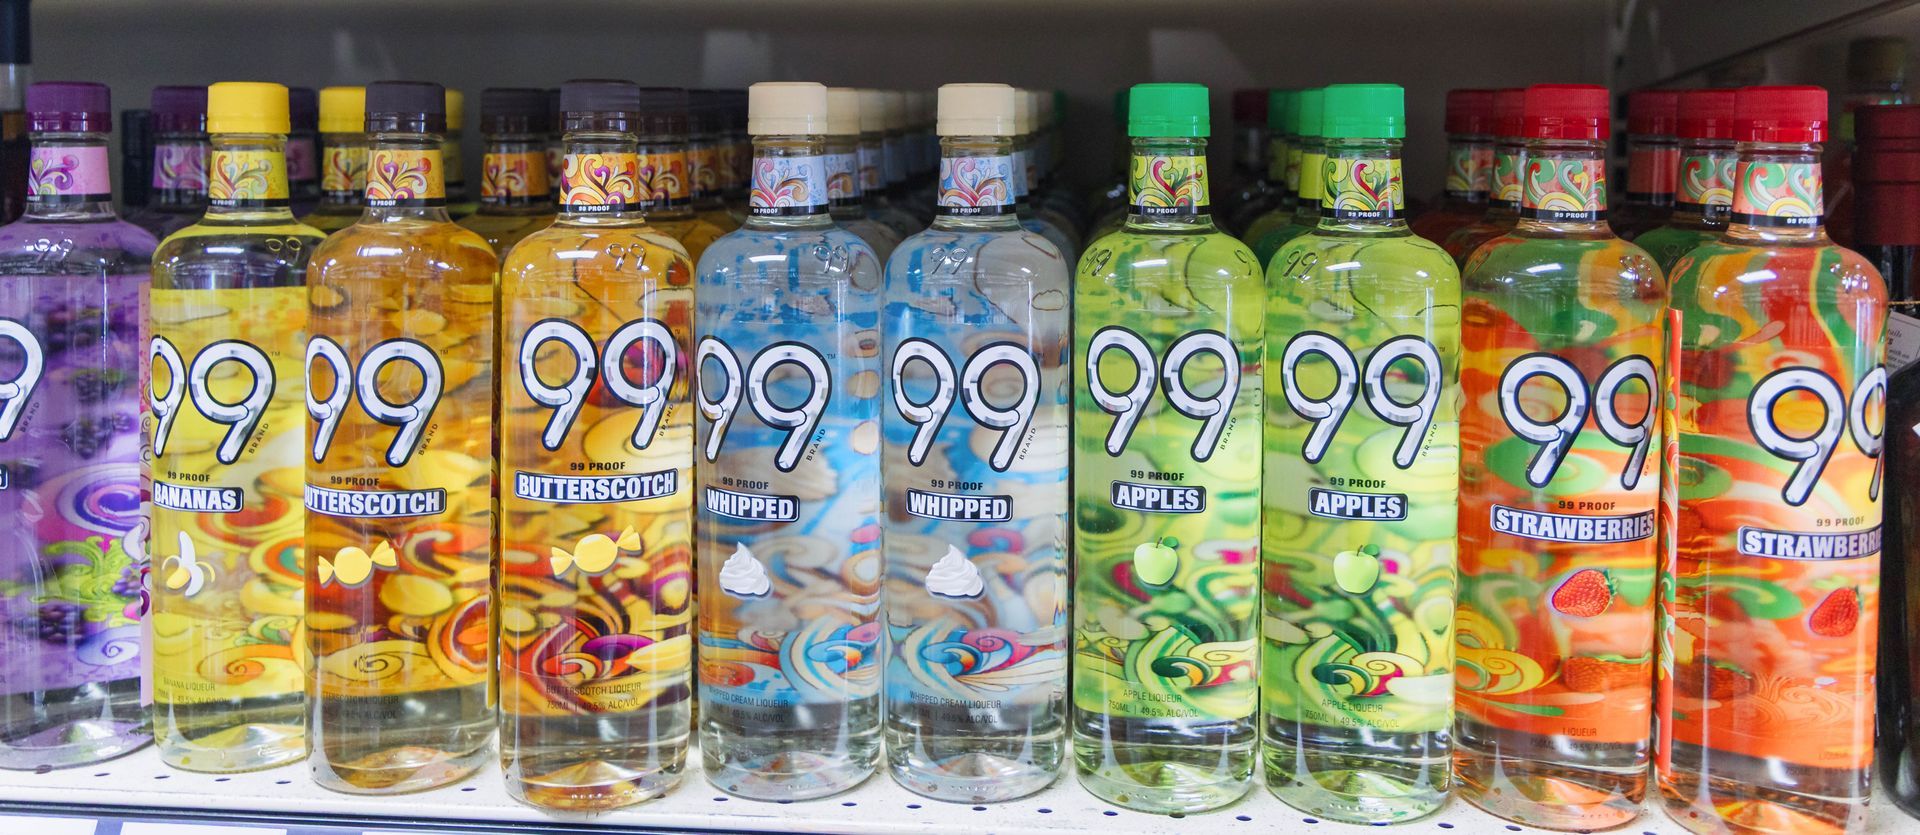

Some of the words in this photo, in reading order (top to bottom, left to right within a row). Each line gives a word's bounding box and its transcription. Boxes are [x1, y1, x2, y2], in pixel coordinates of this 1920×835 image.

[930, 248, 968, 275] 99
[1283, 250, 1318, 280] 99
[519, 317, 678, 452] 99
[1086, 325, 1242, 463] 99
[150, 334, 277, 466] 99
[305, 333, 446, 468] 99
[697, 334, 833, 473] 99
[892, 336, 1042, 473] 99
[1280, 330, 1443, 470] 99
[20, 402, 40, 432] BRAND
[659, 404, 674, 437] BRAND
[1498, 352, 1659, 491] 99
[248, 423, 269, 454] BRAND
[418, 422, 439, 456] BRAND
[806, 428, 826, 462] BRAND
[1018, 427, 1037, 460] BRAND
[1220, 416, 1237, 450] BRAND
[1422, 424, 1438, 457] BRAND
[1746, 362, 1887, 507] 99
[168, 471, 177, 480] 99
[180, 472, 210, 482] PROOF
[570, 462, 585, 471] 99
[588, 462, 626, 471] PROOF
[1130, 470, 1144, 479] 99
[1148, 471, 1184, 481] PROOF
[330, 476, 342, 484] 99
[346, 477, 380, 486] PROOF
[519, 472, 675, 500] BUTTERSCOTCH
[722, 476, 734, 486] 99
[736, 480, 770, 490] PROOF
[931, 480, 944, 489] 99
[948, 481, 984, 491] PROOF
[1330, 477, 1344, 486] 99
[1349, 478, 1386, 488] PROOF
[154, 482, 237, 511] BANANAS
[706, 488, 794, 520] WHIPPED
[910, 491, 1008, 520] WHIPPED
[1116, 484, 1200, 510] APPLES
[1315, 492, 1401, 519] APPLES
[1558, 500, 1574, 510] 99
[1579, 501, 1616, 511] PROOF
[1496, 508, 1654, 541] STRAWBERRIES
[1816, 518, 1830, 526] 99
[1836, 516, 1864, 526] PROOF
[186, 681, 216, 692] LIQUEUR
[546, 684, 606, 696] BUTTERSCOTCH
[609, 682, 641, 694] LIQUEUR
[910, 690, 938, 705] WHIPPED
[940, 698, 966, 708] CREAM
[968, 700, 1001, 709] LIQUEUR
[1123, 689, 1146, 700] APPLE
[1148, 692, 1182, 702] LIQUEUR
[608, 697, 640, 710] ALC/VOL
[731, 694, 754, 706] CREAM
[756, 699, 789, 708] LIQUEUR
[1109, 700, 1130, 712] 750ML
[1141, 706, 1164, 717] 49.5%
[1166, 708, 1199, 718] ALC/VOL
[1322, 699, 1347, 710] APPLE
[1348, 703, 1383, 712] LIQUEUR
[966, 714, 998, 724] ALC/VOL
[1305, 710, 1328, 722] 750ML
[1367, 720, 1400, 728] ALC/VOL
[1562, 728, 1598, 736] LIQUEUR
